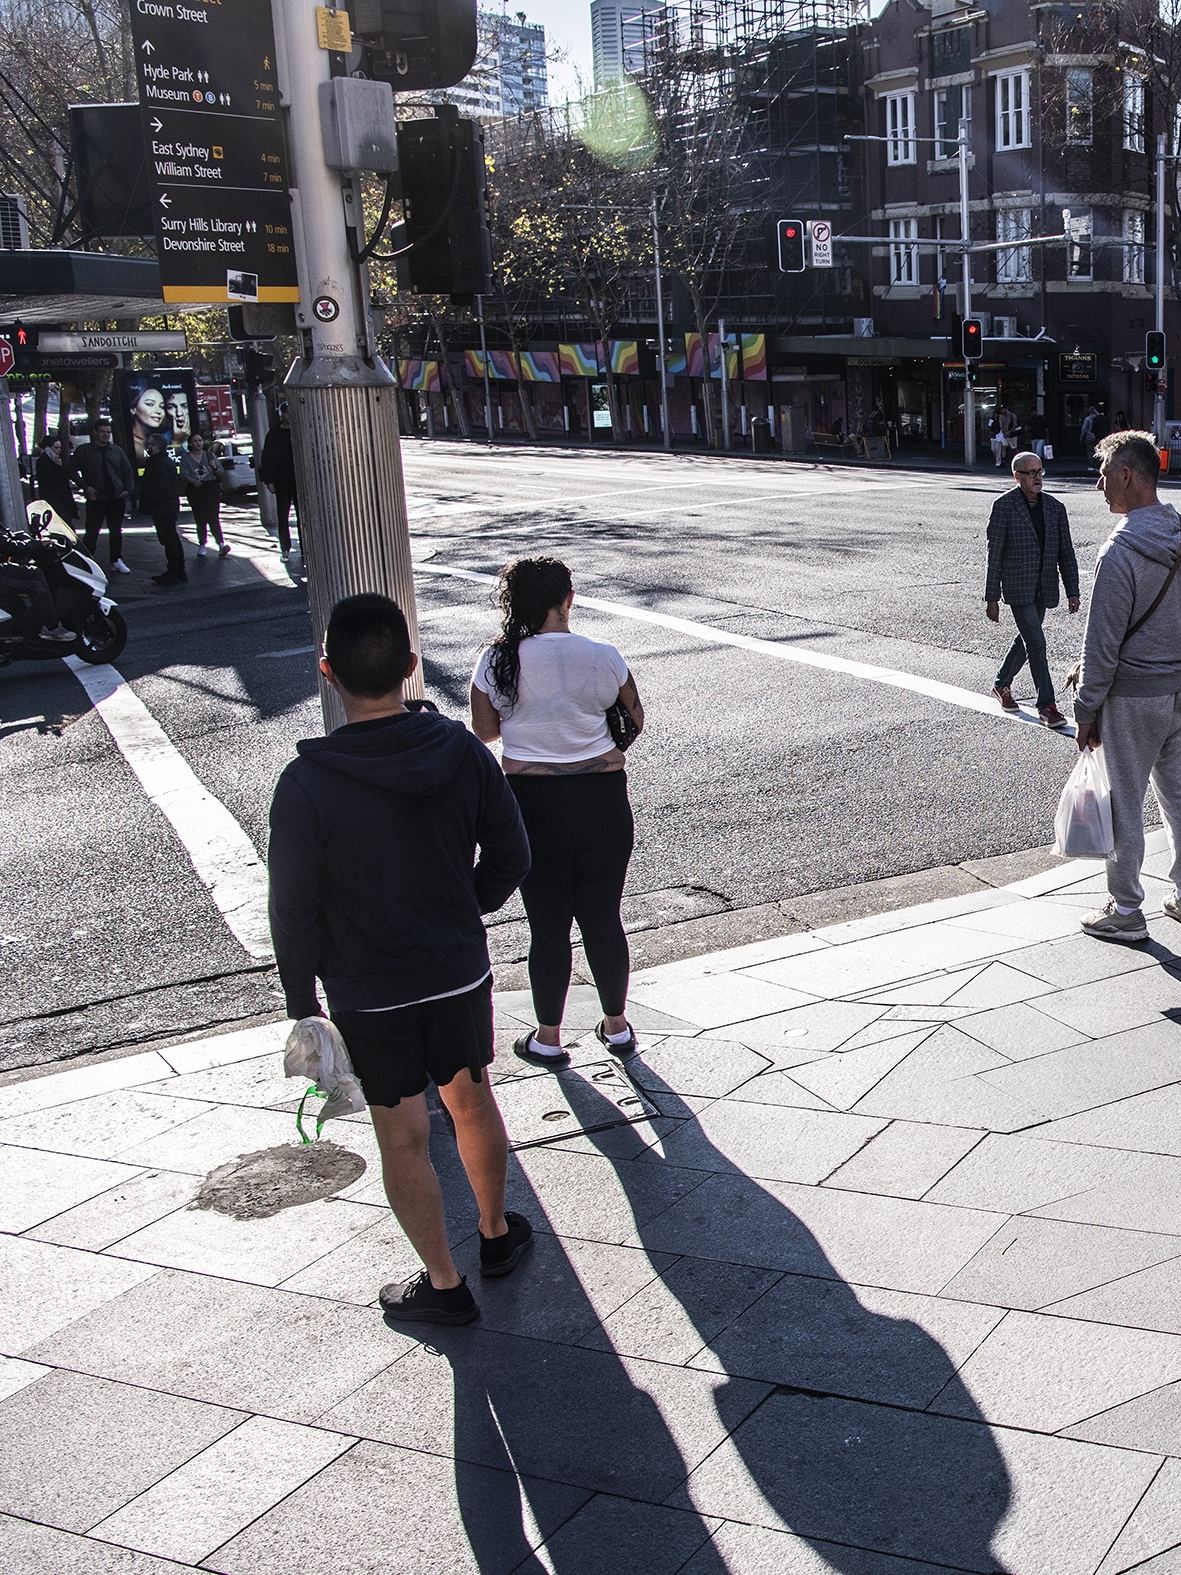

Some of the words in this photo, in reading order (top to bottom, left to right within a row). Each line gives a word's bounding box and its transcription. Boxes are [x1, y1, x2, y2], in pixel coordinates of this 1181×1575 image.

[137, 0, 174, 18] Crown
[177, 4, 208, 23] Street
[143, 63, 170, 82] Hyde
[172, 66, 195, 82] Park
[254, 80, 259, 90] 5
[260, 80, 274, 91] min
[146, 84, 190, 102] Museum
[256, 100, 260, 110] 7
[262, 100, 275, 111] min
[152, 140, 174, 156] East
[176, 142, 210, 161] Sydney
[261, 153, 266, 162] 4
[268, 153, 280, 164] min
[154, 161, 192, 177] William
[194, 164, 222, 180] Street
[263, 172, 268, 182] 7
[269, 172, 282, 183] min
[160, 216, 186, 234] Surry
[188, 218, 209, 232] Hills
[210, 218, 242, 236] Library
[265, 224, 274, 234] 10
[274, 224, 288, 234] min
[163, 237, 216, 252] Devonshire
[218, 238, 246, 252] Street
[267, 244, 276, 252] 18
[276, 244, 290, 254] min
[82, 336, 138, 348] SANDOITCHI
[42, 356, 110, 366] anetdwellers
